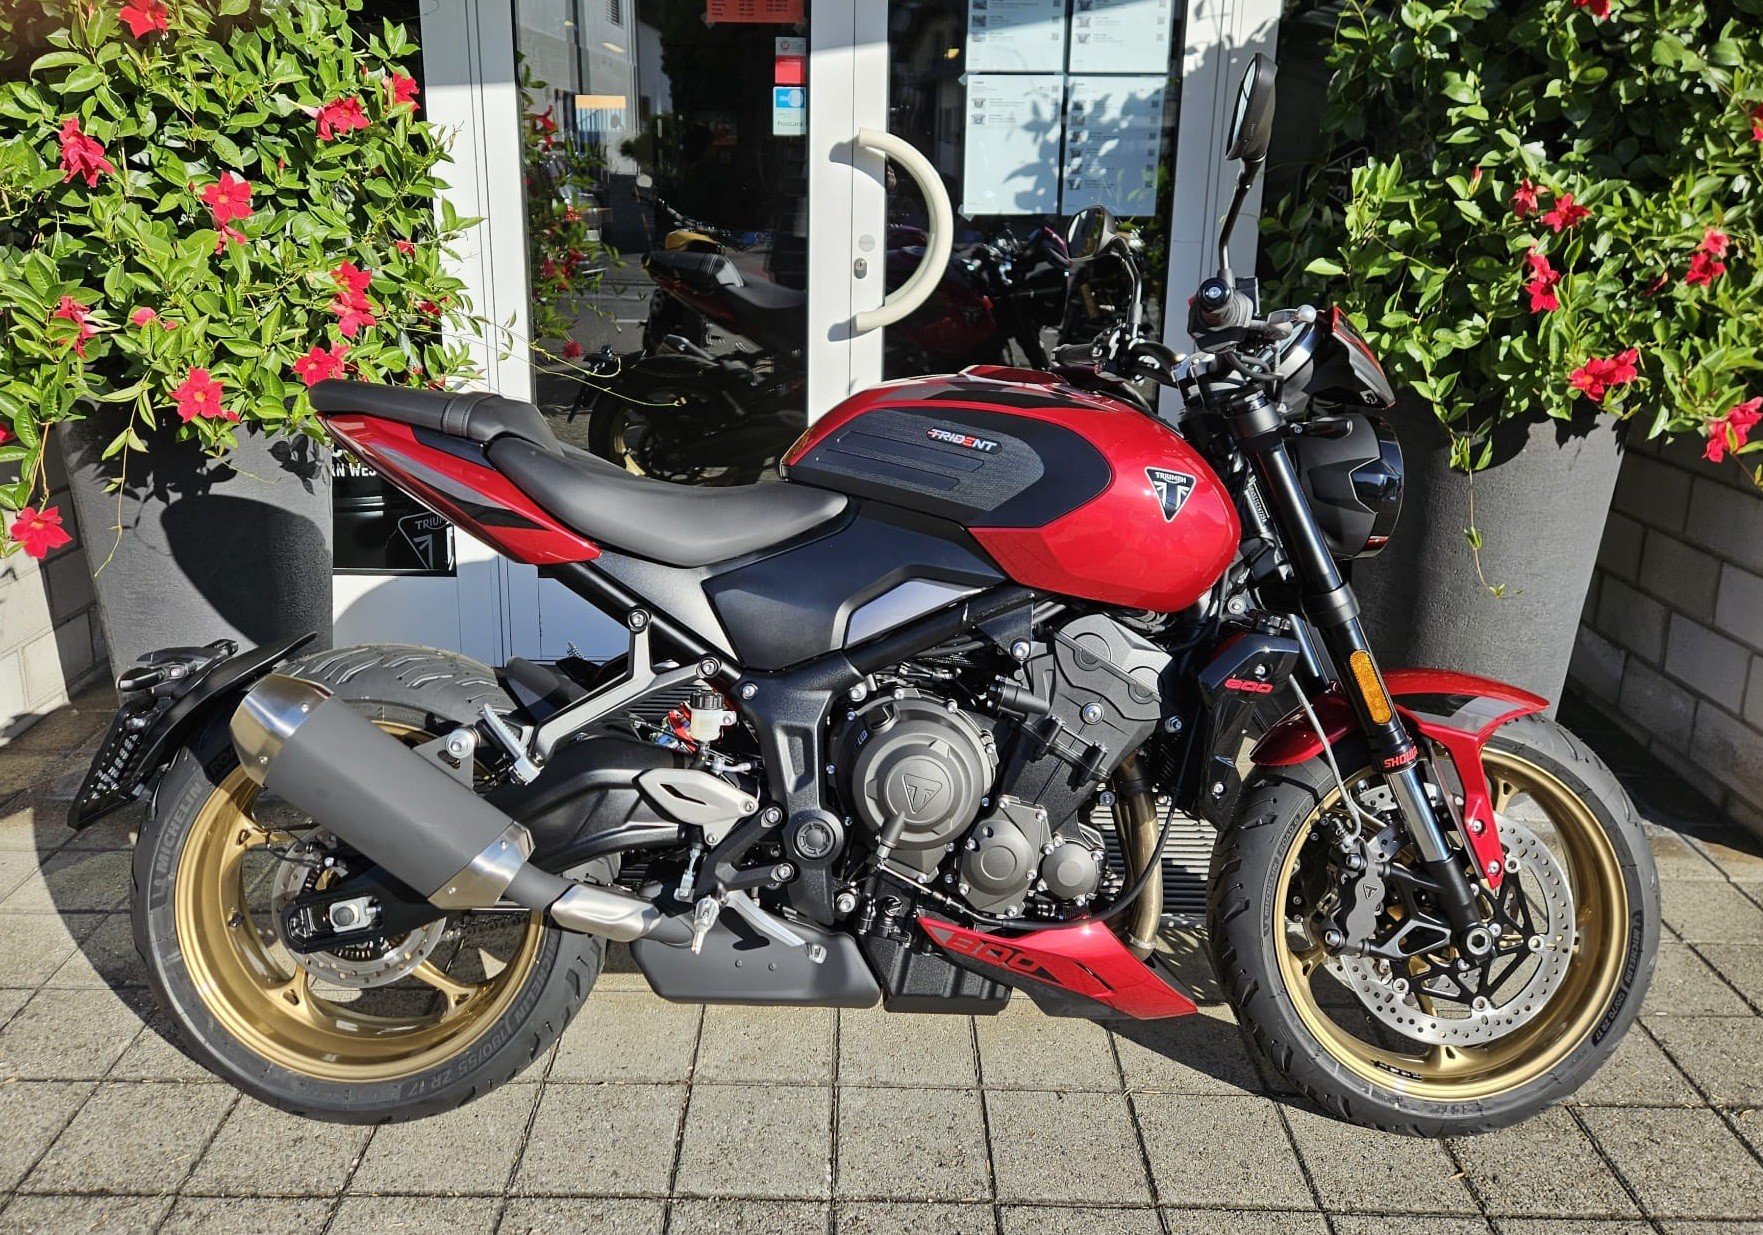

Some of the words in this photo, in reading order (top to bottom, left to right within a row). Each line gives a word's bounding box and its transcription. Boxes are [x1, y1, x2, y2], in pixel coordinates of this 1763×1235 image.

[927, 428, 997, 451] TRIDENT
[1155, 471, 1187, 484] TRIUMPH
[1384, 745, 1418, 768] SHOWA
[155, 781, 202, 874] MICHELIN
[459, 1022, 508, 1076] 180/55
[407, 1080, 425, 1097] 17
[431, 1069, 453, 1090] ZR
